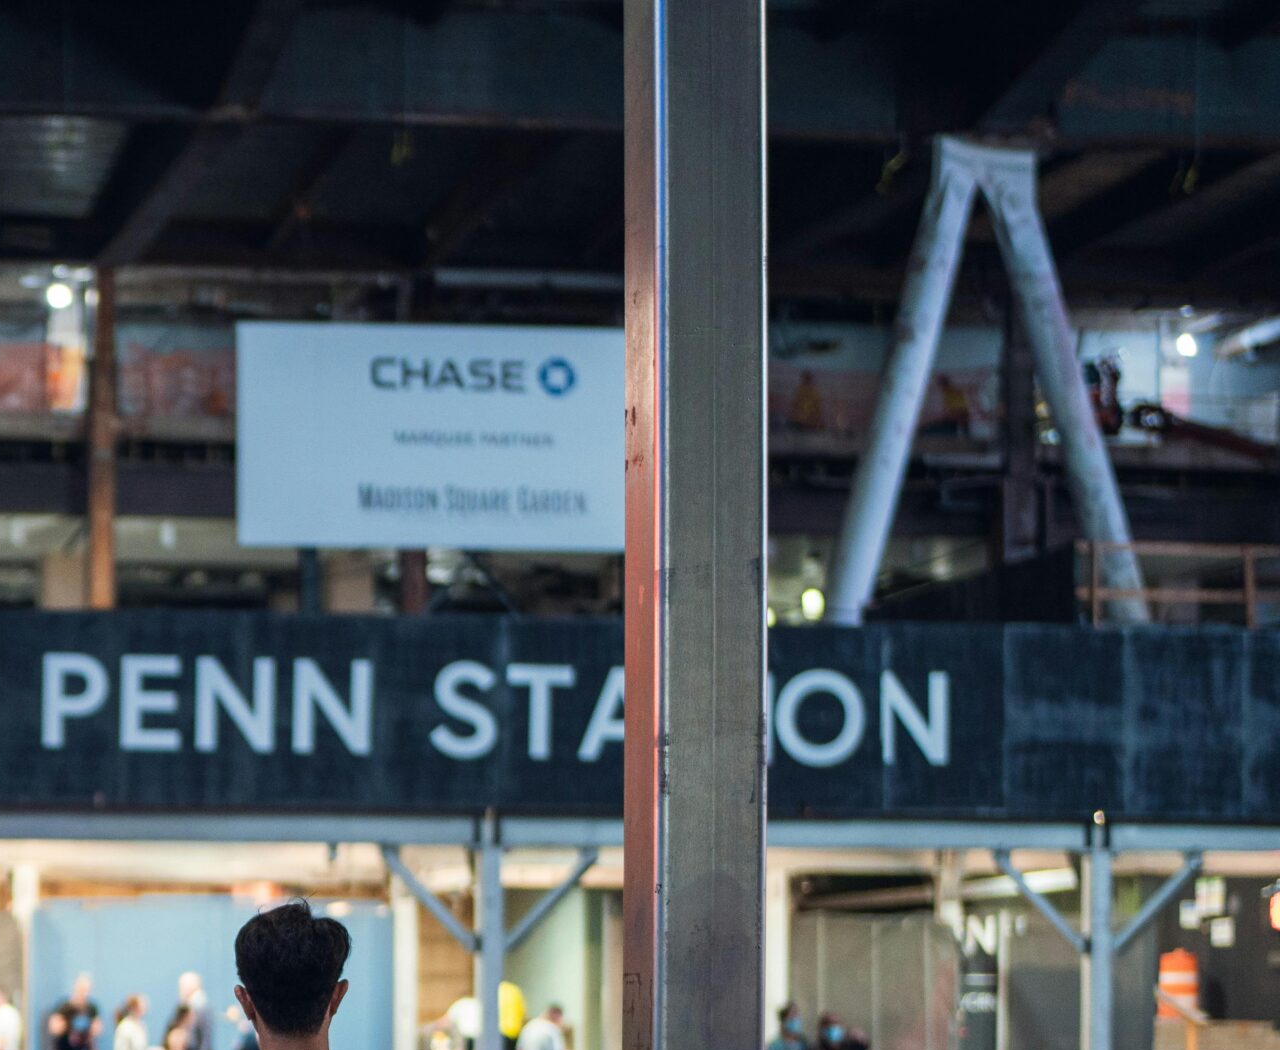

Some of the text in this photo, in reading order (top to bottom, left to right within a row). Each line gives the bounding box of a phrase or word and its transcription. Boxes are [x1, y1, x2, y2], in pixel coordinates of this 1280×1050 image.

[370, 356, 526, 394] CHASE
[40, 651, 951, 767] PENN STAON
